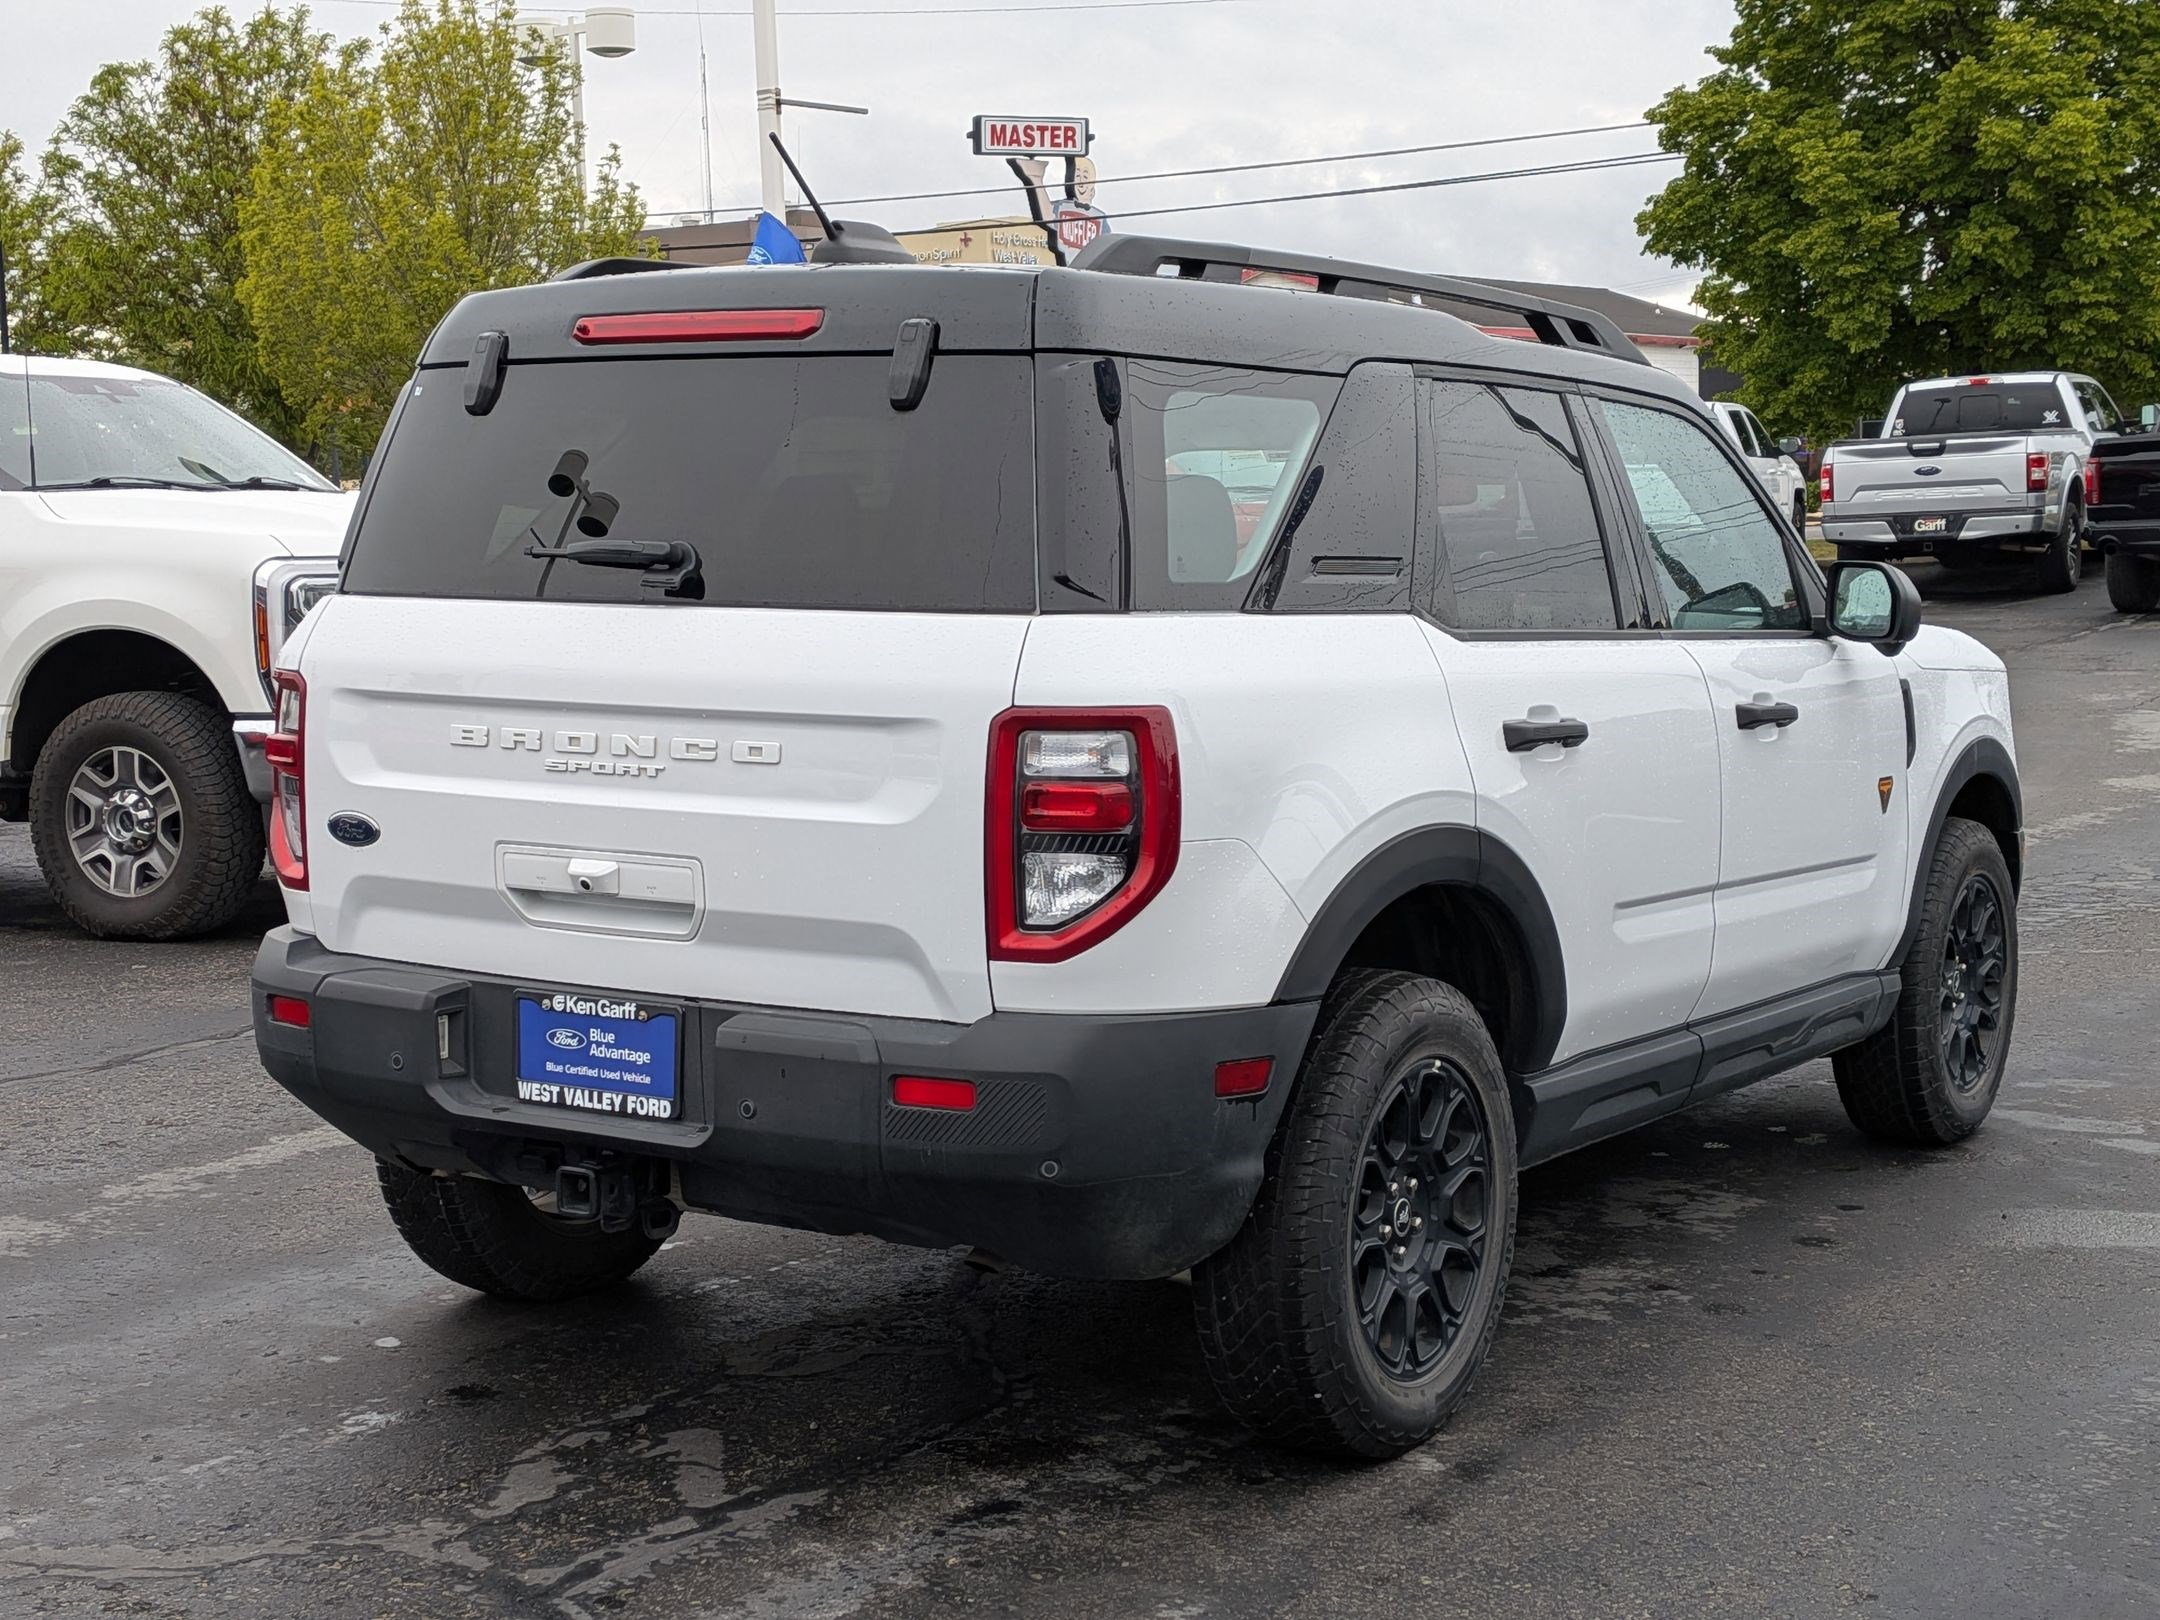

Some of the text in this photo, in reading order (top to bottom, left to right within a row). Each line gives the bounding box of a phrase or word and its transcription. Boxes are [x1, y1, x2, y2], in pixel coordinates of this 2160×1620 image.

[990, 124, 1077, 148] MASTER
[992, 230, 1011, 248] Holy
[993, 248, 1016, 263] West
[1914, 518, 1947, 532] Garff
[450, 724, 782, 765] BRONCO
[545, 758, 666, 778] SPORT
[566, 996, 637, 1020] Ken Garff
[553, 1031, 579, 1047] Ford
[590, 1028, 615, 1043] Blue
[589, 1044, 651, 1065] Advantage
[546, 1062, 651, 1084] Blue Certified Used Vehicle
[518, 1081, 672, 1118] WEST VALLEY FORD
